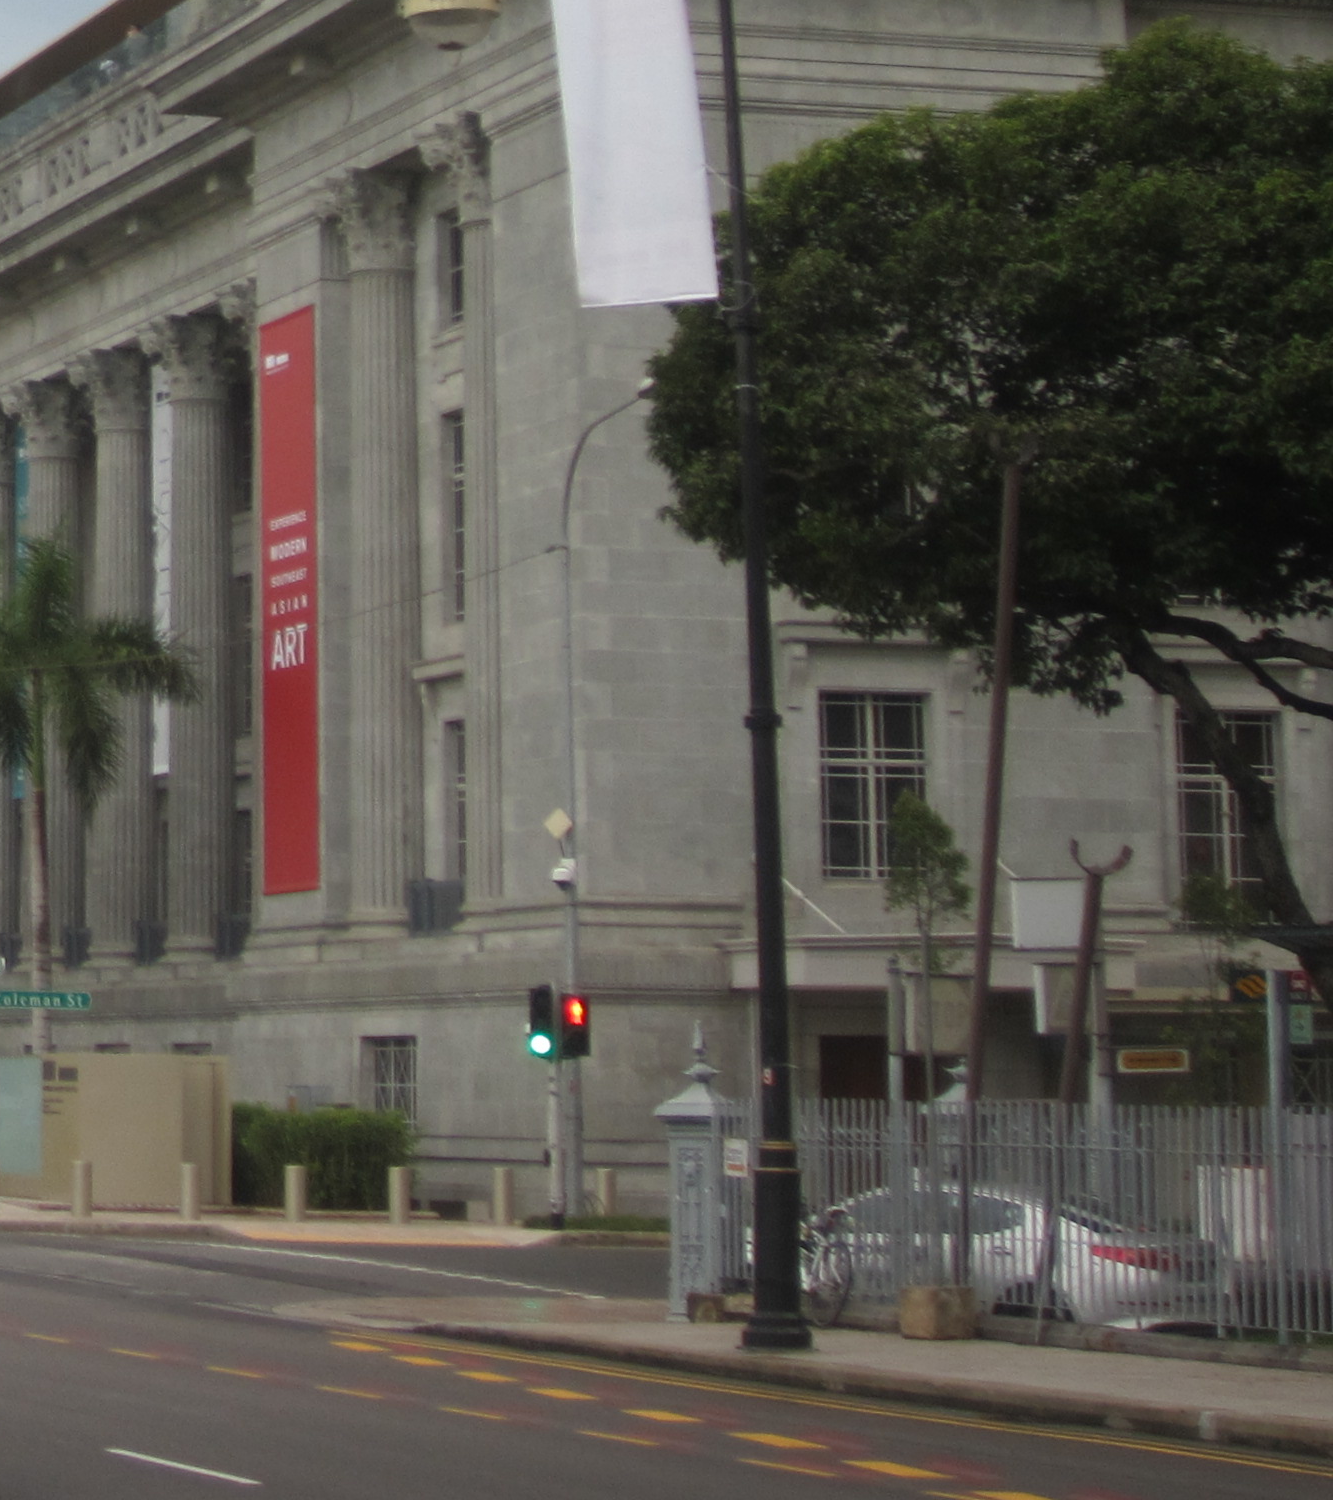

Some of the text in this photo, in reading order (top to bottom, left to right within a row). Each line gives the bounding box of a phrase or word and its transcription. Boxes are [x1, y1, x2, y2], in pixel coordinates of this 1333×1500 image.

[270, 510, 307, 531] EXPERIENCE
[270, 536, 308, 561] MODERN
[270, 567, 307, 588] SOUTHEAST
[271, 593, 308, 615] ASIAN
[271, 622, 308, 671] ART
[66, 993, 83, 1008] St
